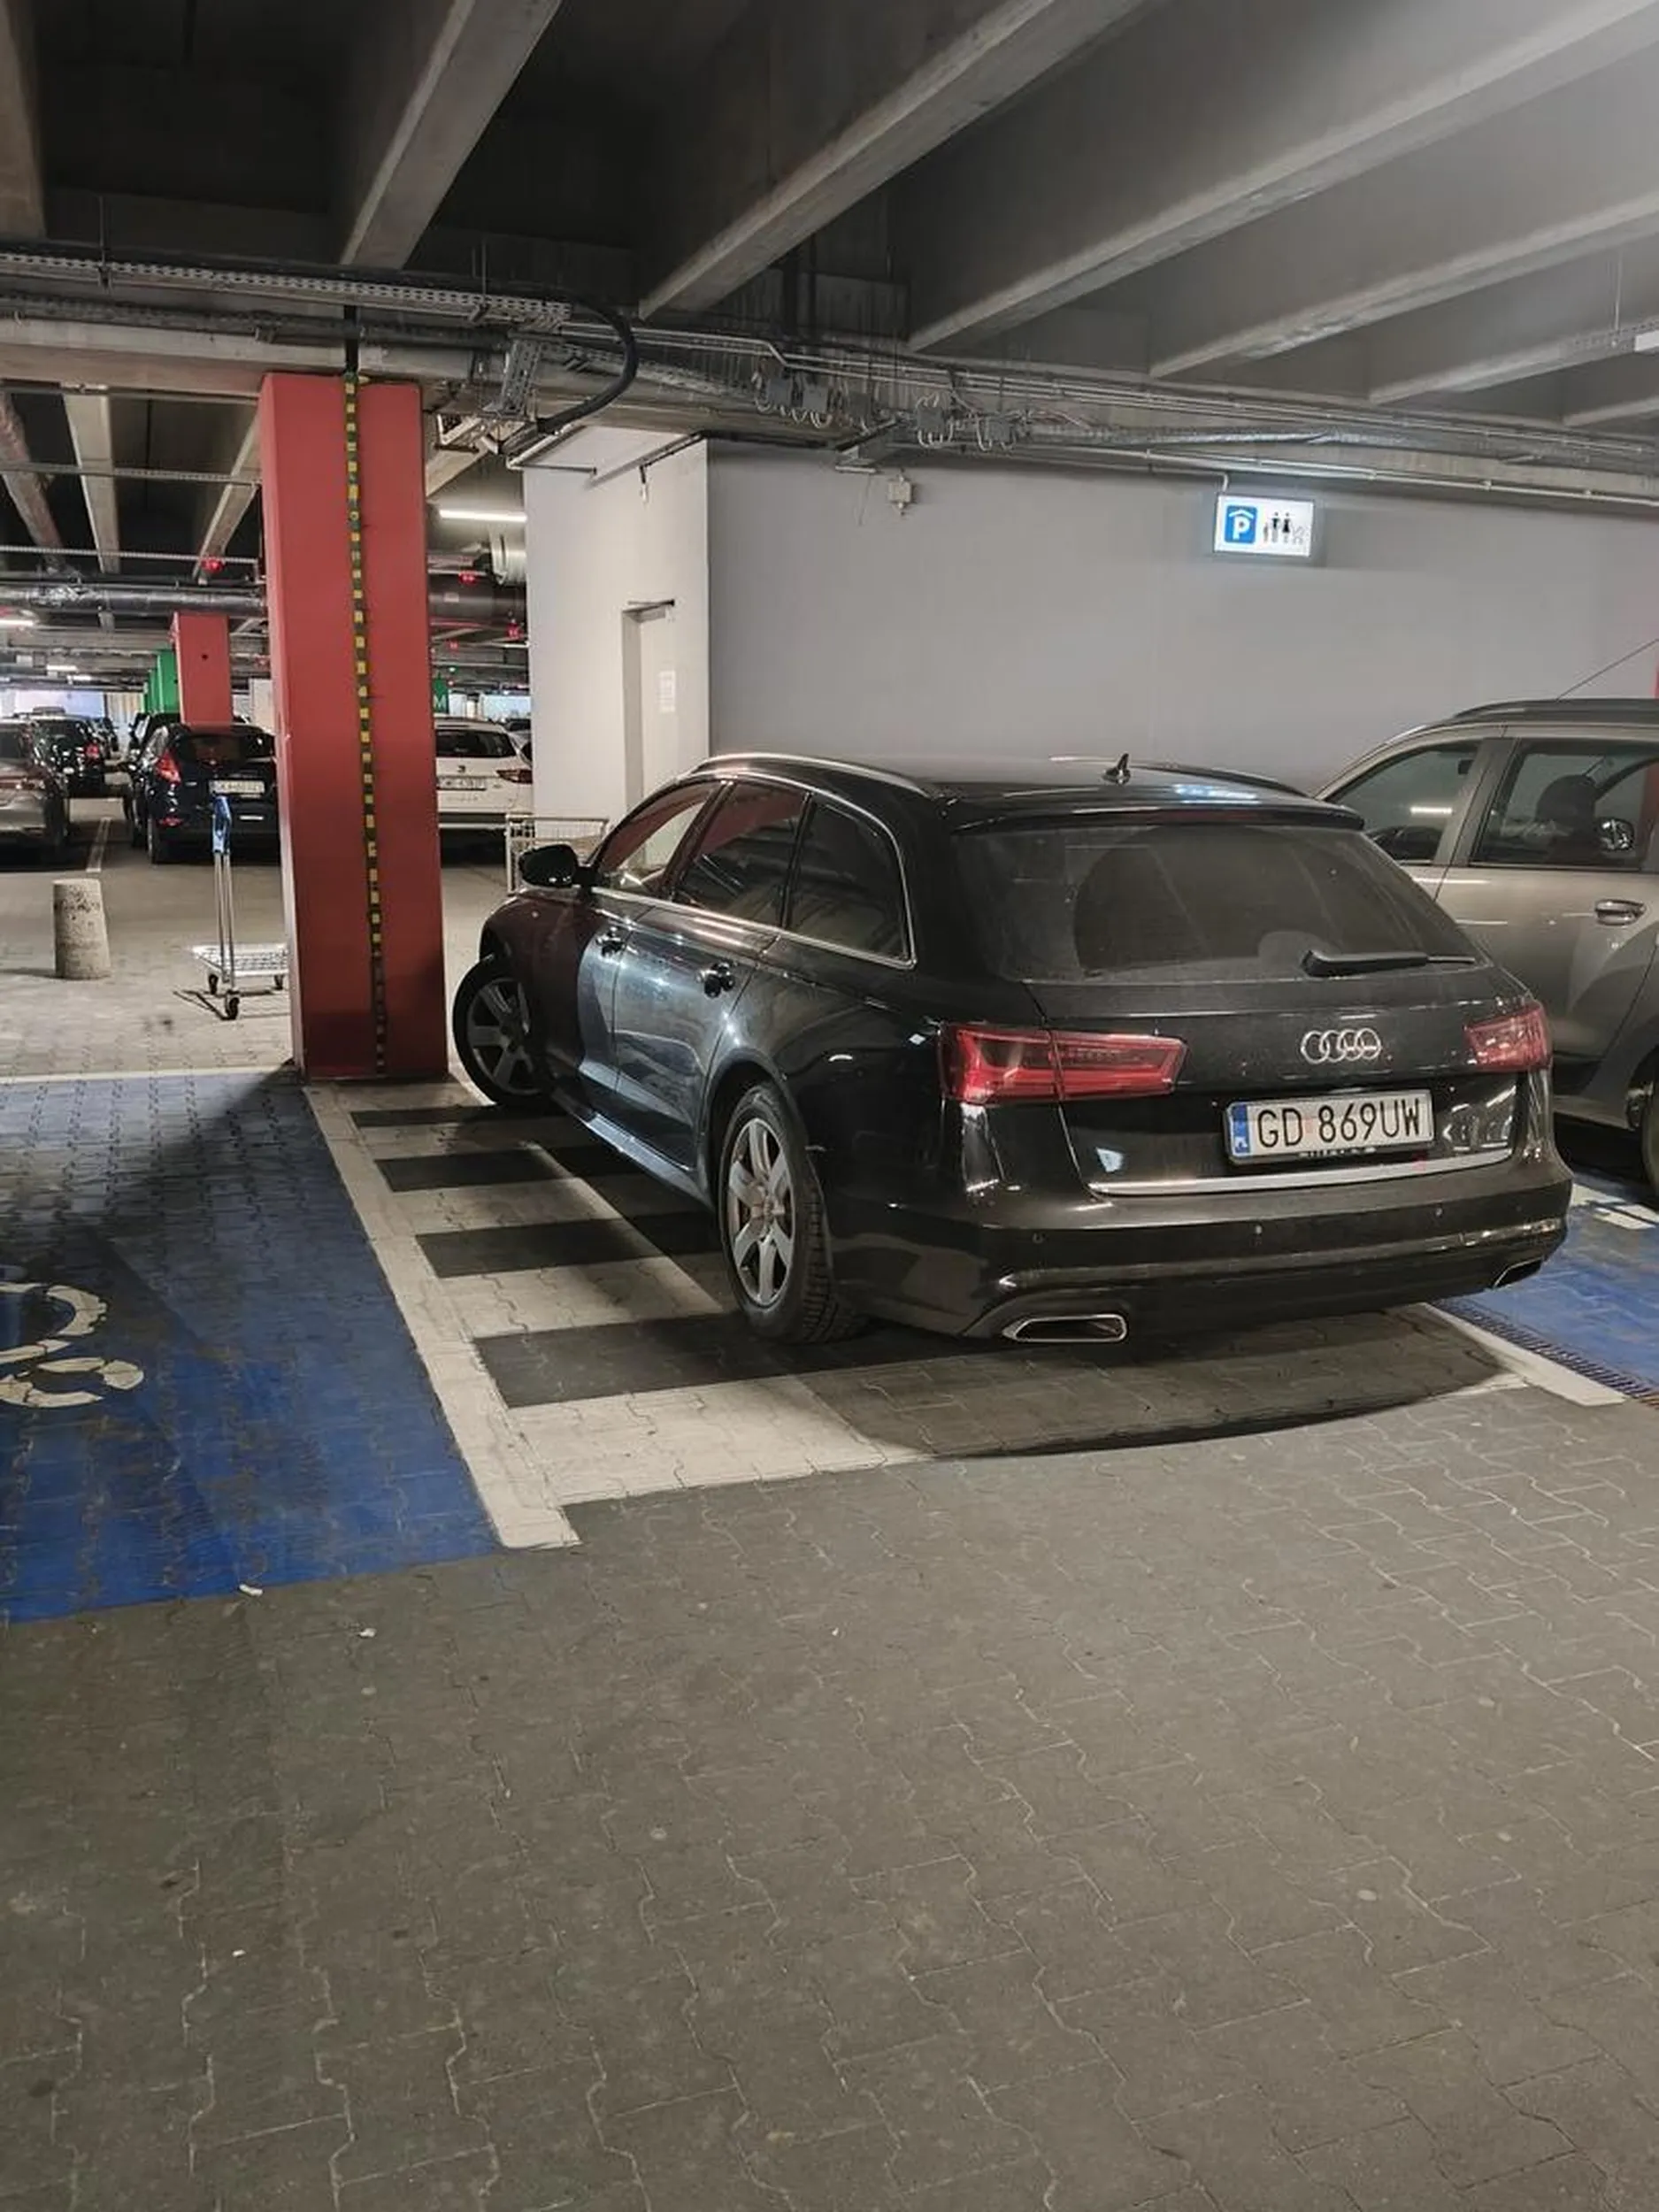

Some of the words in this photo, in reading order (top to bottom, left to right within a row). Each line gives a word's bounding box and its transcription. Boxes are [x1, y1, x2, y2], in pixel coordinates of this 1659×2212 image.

[1233, 515, 1251, 541] P
[1257, 1107, 1303, 1148] GD
[1317, 1098, 1420, 1143] 869UW
